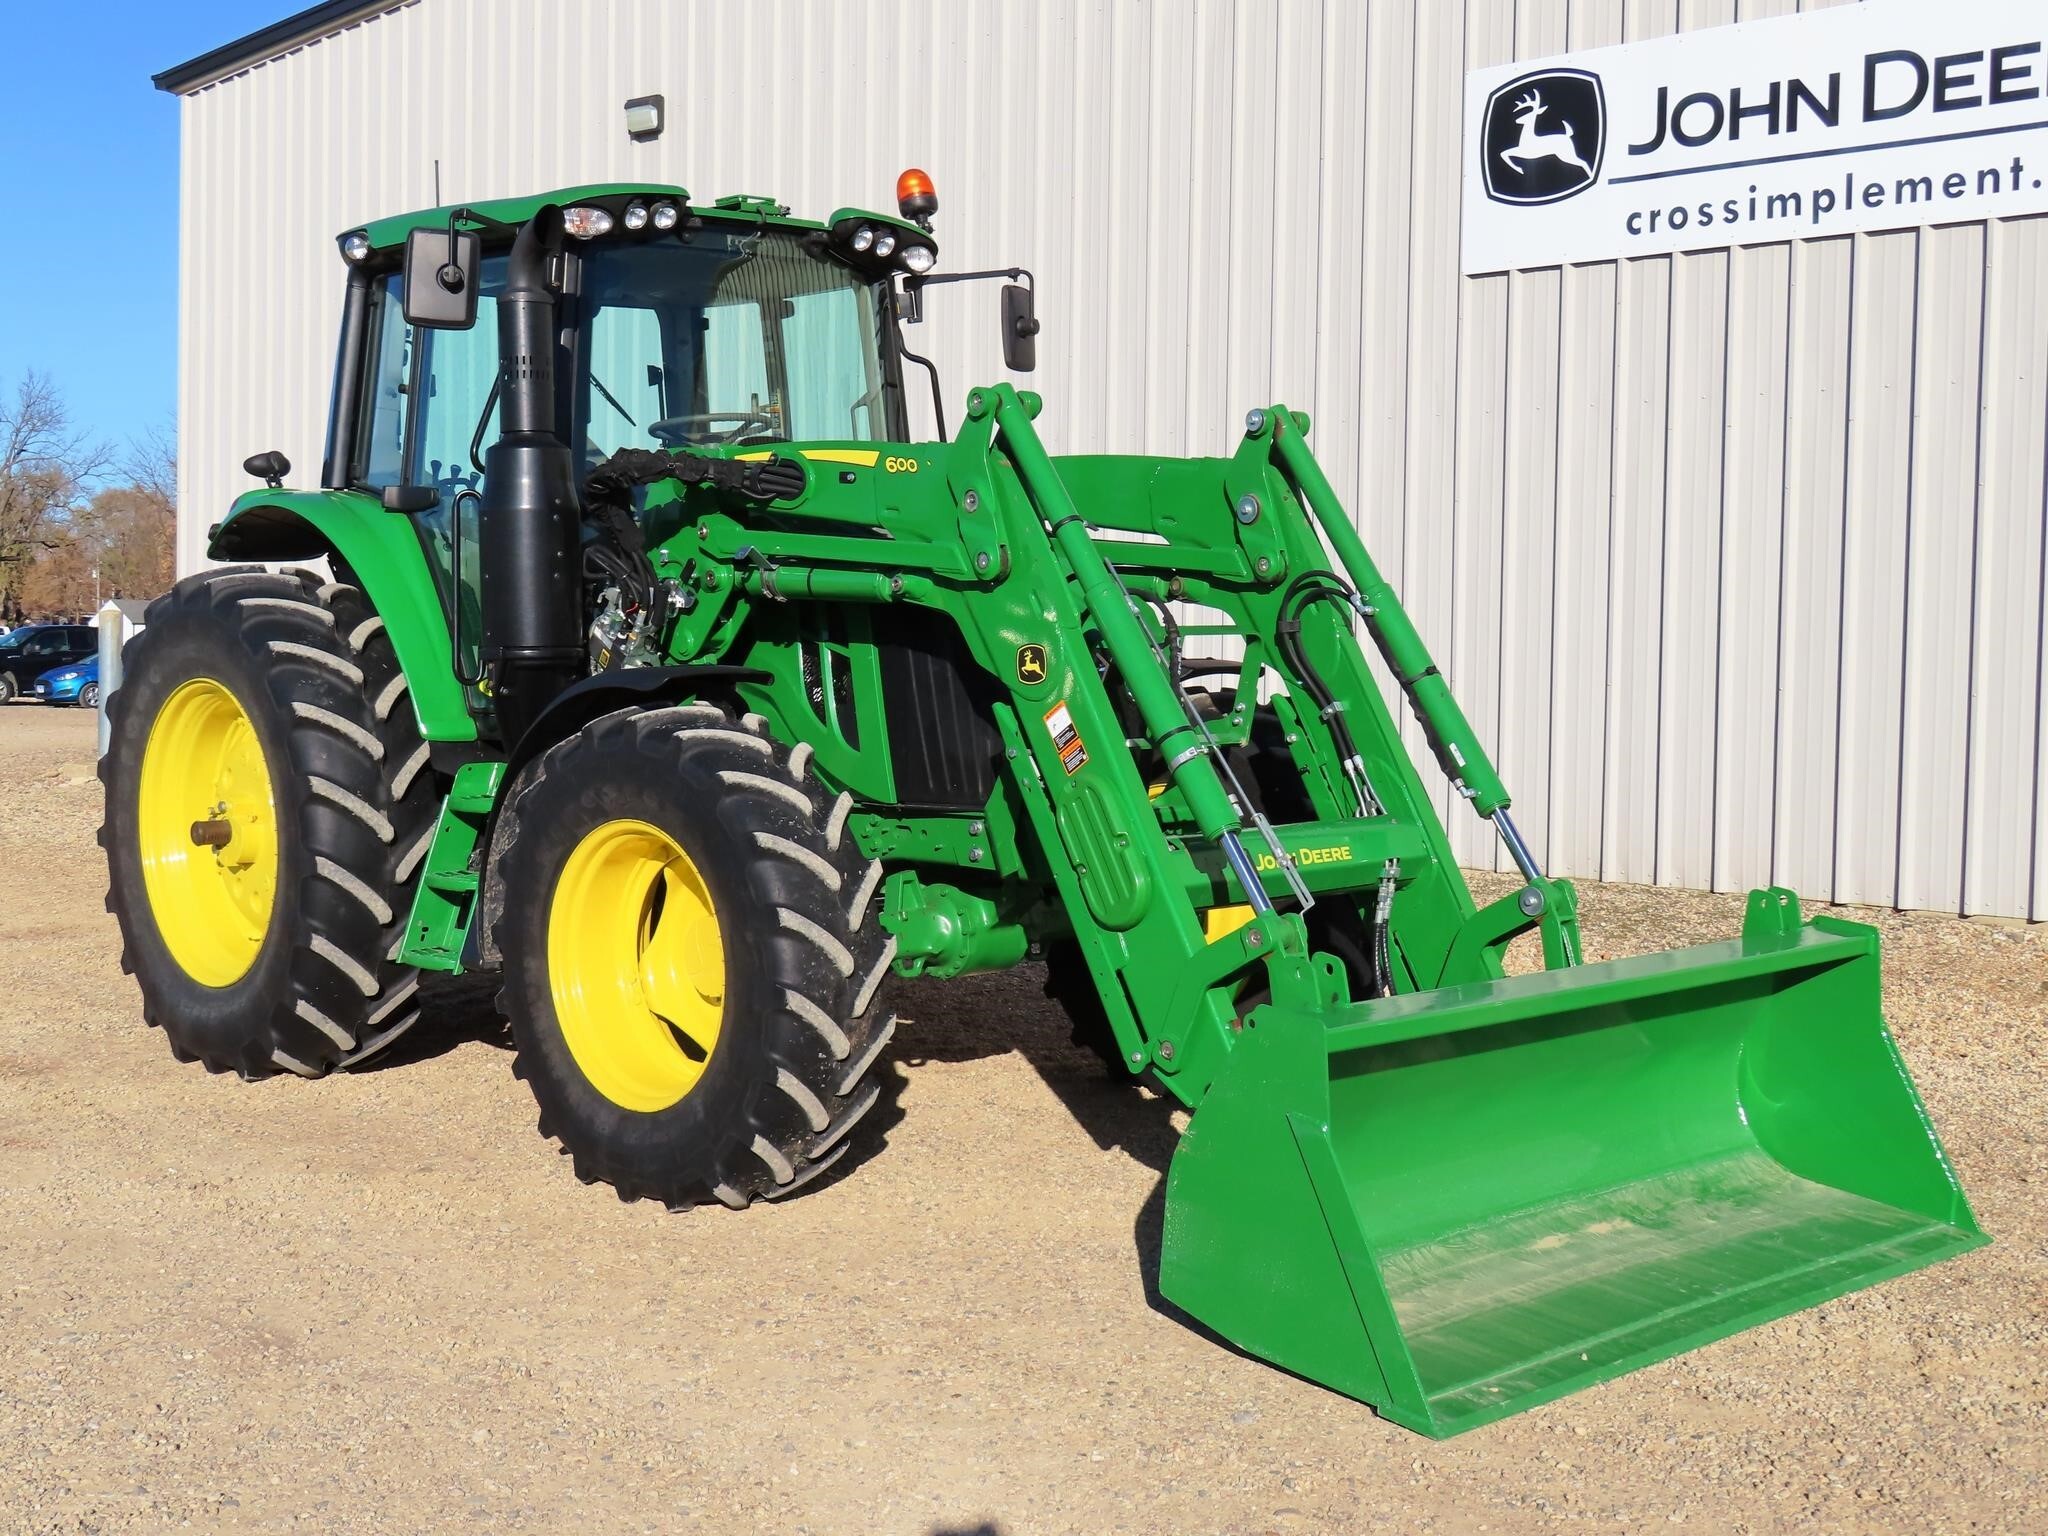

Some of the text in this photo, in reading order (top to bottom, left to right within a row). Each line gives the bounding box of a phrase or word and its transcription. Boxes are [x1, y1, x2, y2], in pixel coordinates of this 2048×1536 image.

[1628, 41, 2048, 155] JOHN DEE
[1626, 157, 2042, 235] crossimplement.
[885, 456, 918, 473] 600
[1256, 846, 1353, 871] JON DEERE
